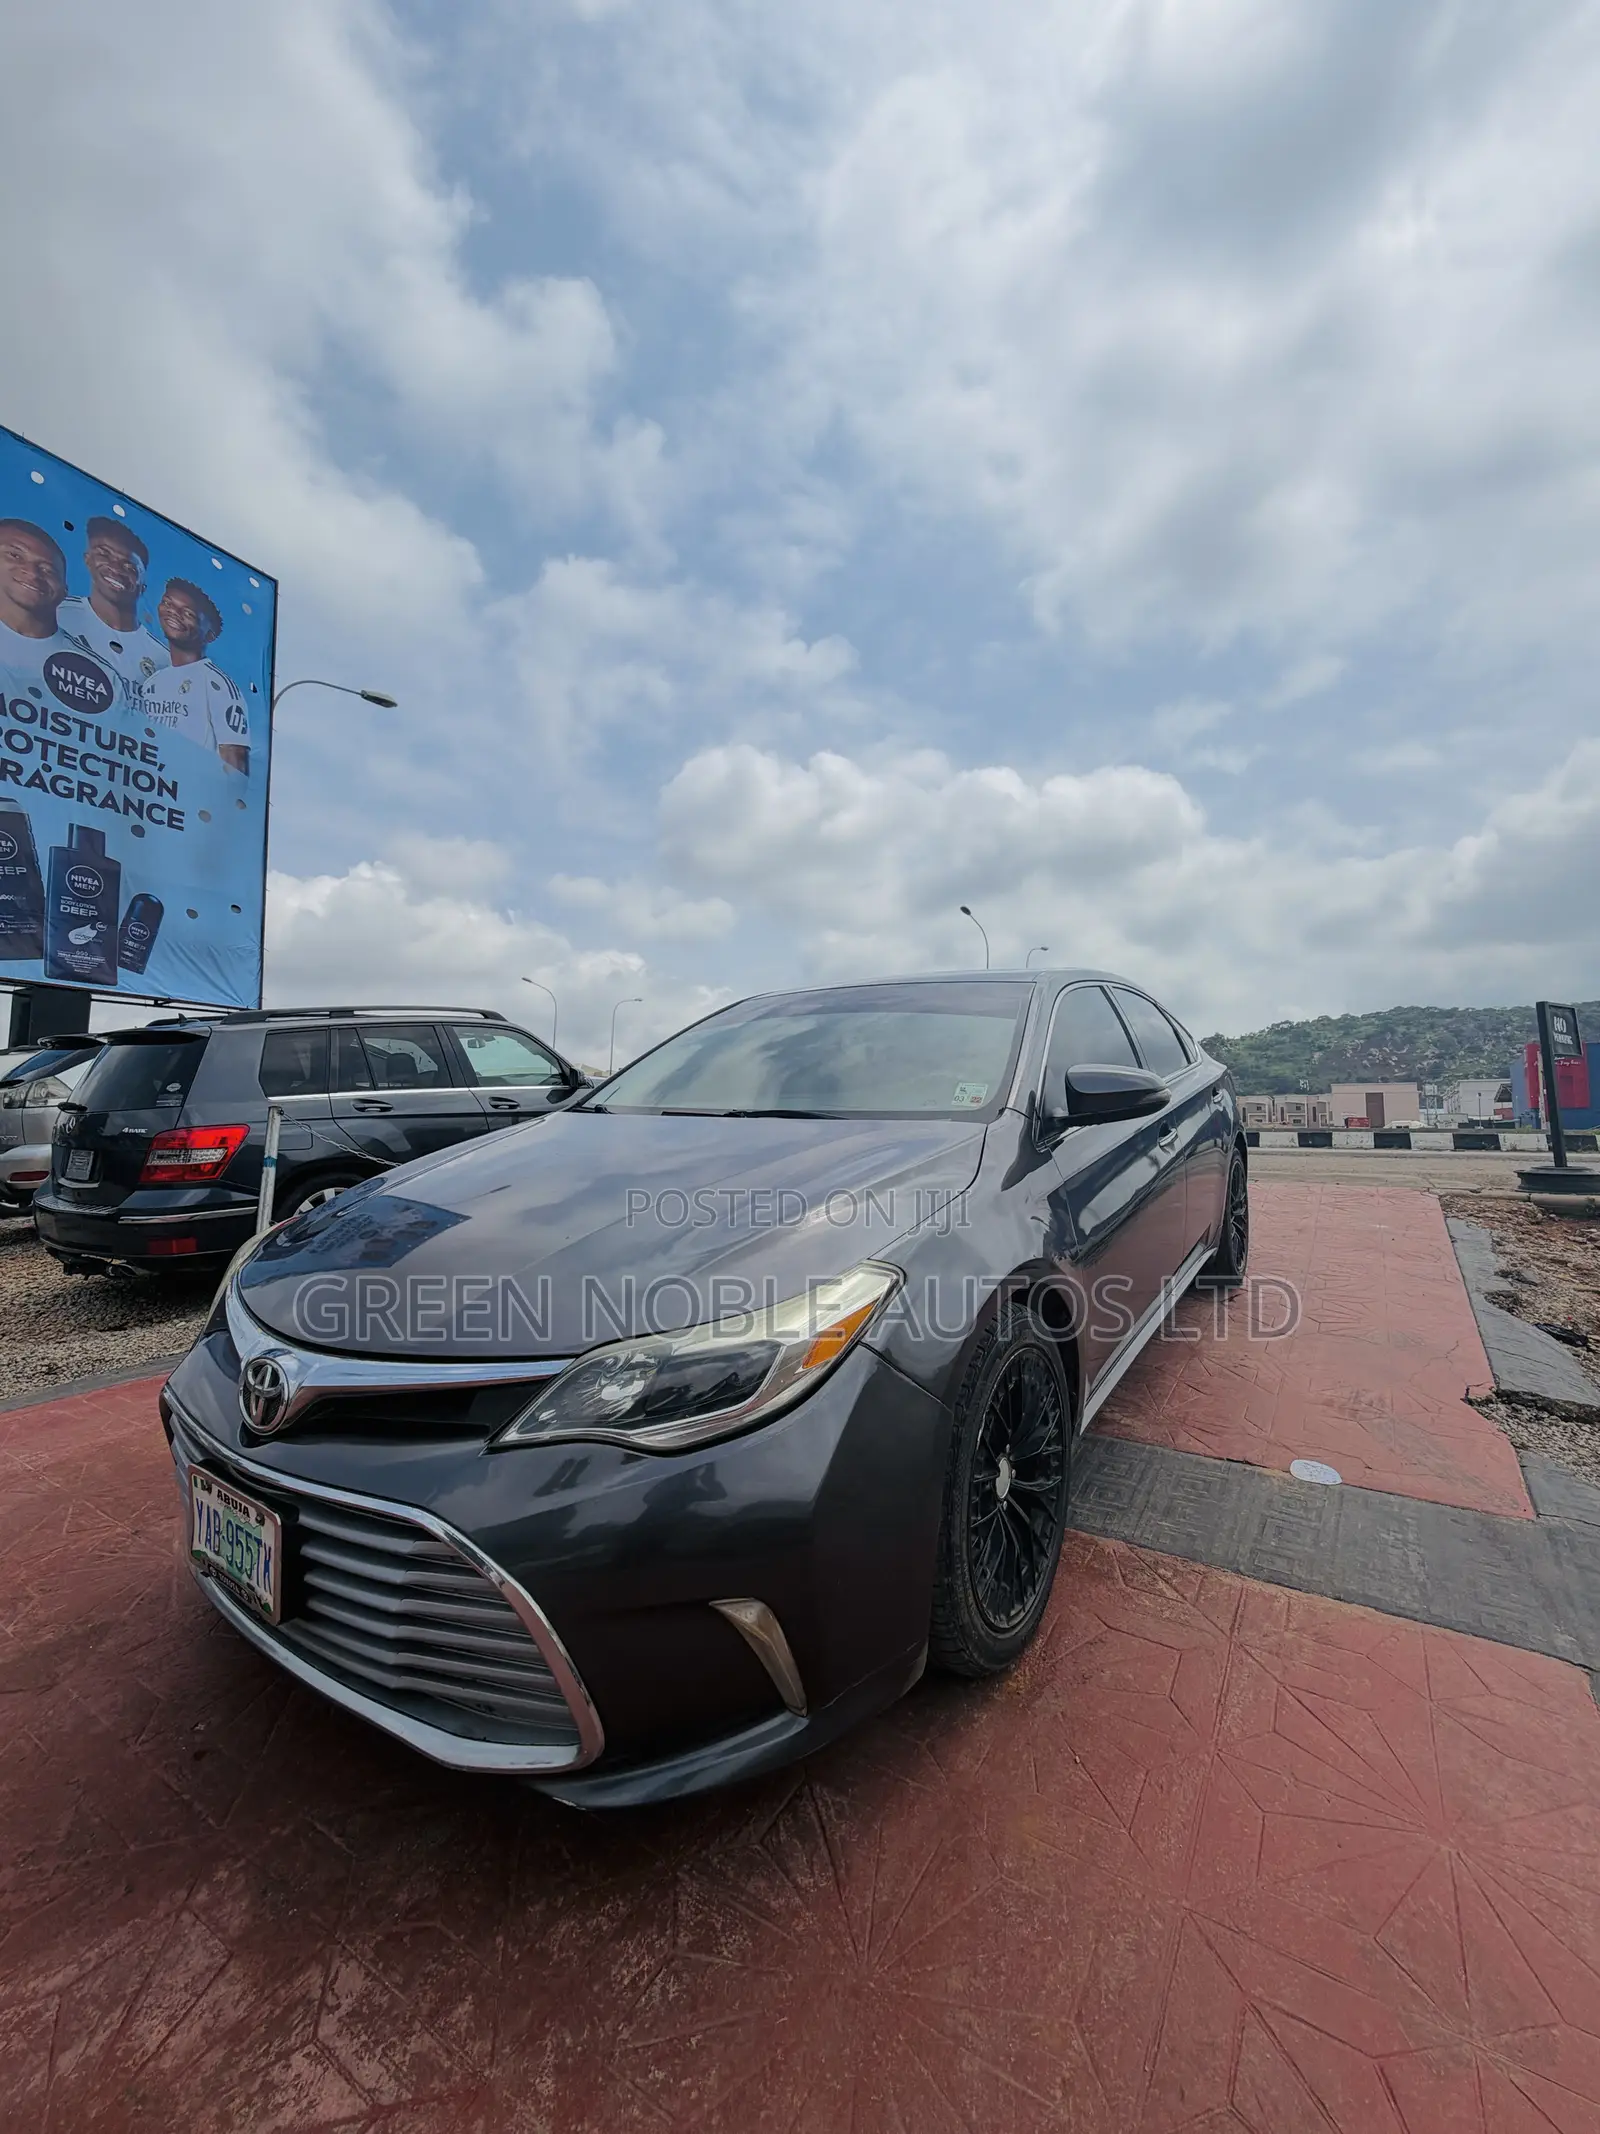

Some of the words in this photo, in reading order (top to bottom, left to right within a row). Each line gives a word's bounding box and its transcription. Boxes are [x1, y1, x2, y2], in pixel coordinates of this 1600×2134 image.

[51, 663, 108, 697] NIVEA
[58, 680, 99, 704] MEN
[0, 726, 179, 802] OTECTION
[0, 866, 27, 875] EEP
[71, 874, 99, 886] NIVEA
[74, 882, 96, 891] MEN
[60, 904, 98, 917] DEEP
[1553, 1016, 1567, 1033] NO
